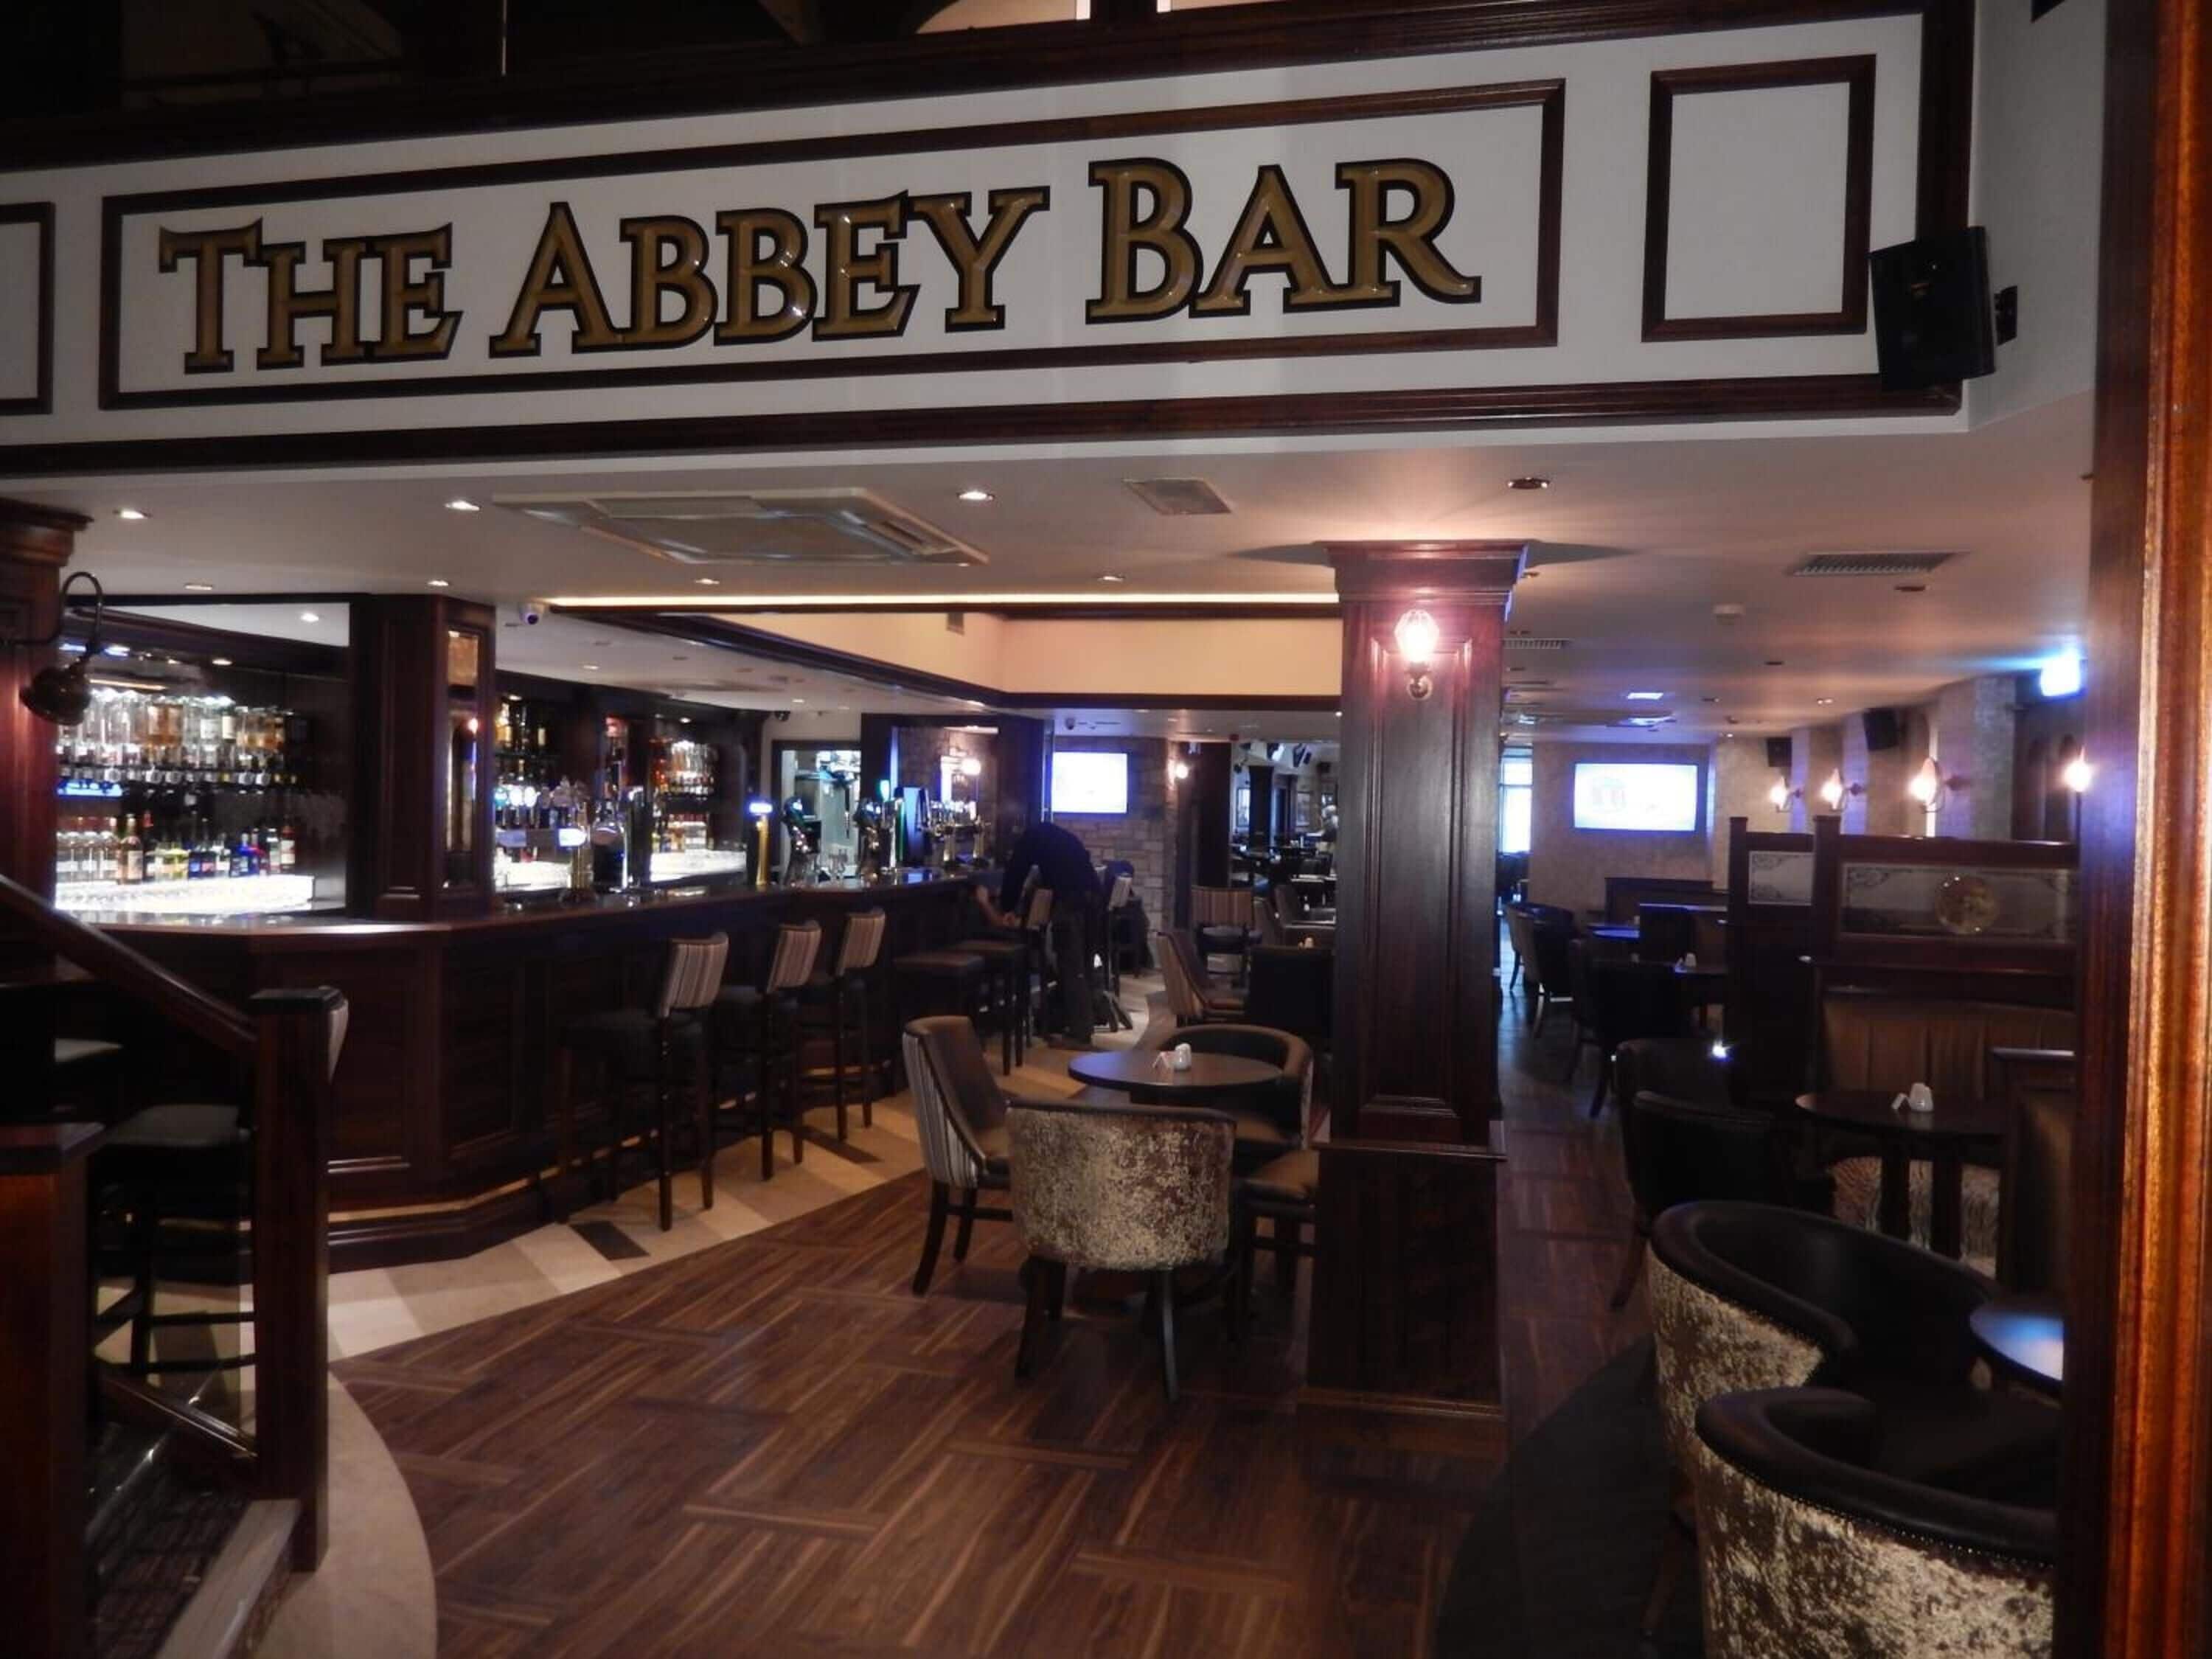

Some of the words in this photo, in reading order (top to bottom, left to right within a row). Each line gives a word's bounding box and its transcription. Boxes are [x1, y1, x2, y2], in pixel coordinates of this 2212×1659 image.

[159, 217, 464, 374] THE
[490, 186, 1050, 358] ABBEY
[1085, 157, 1483, 324] BAR
